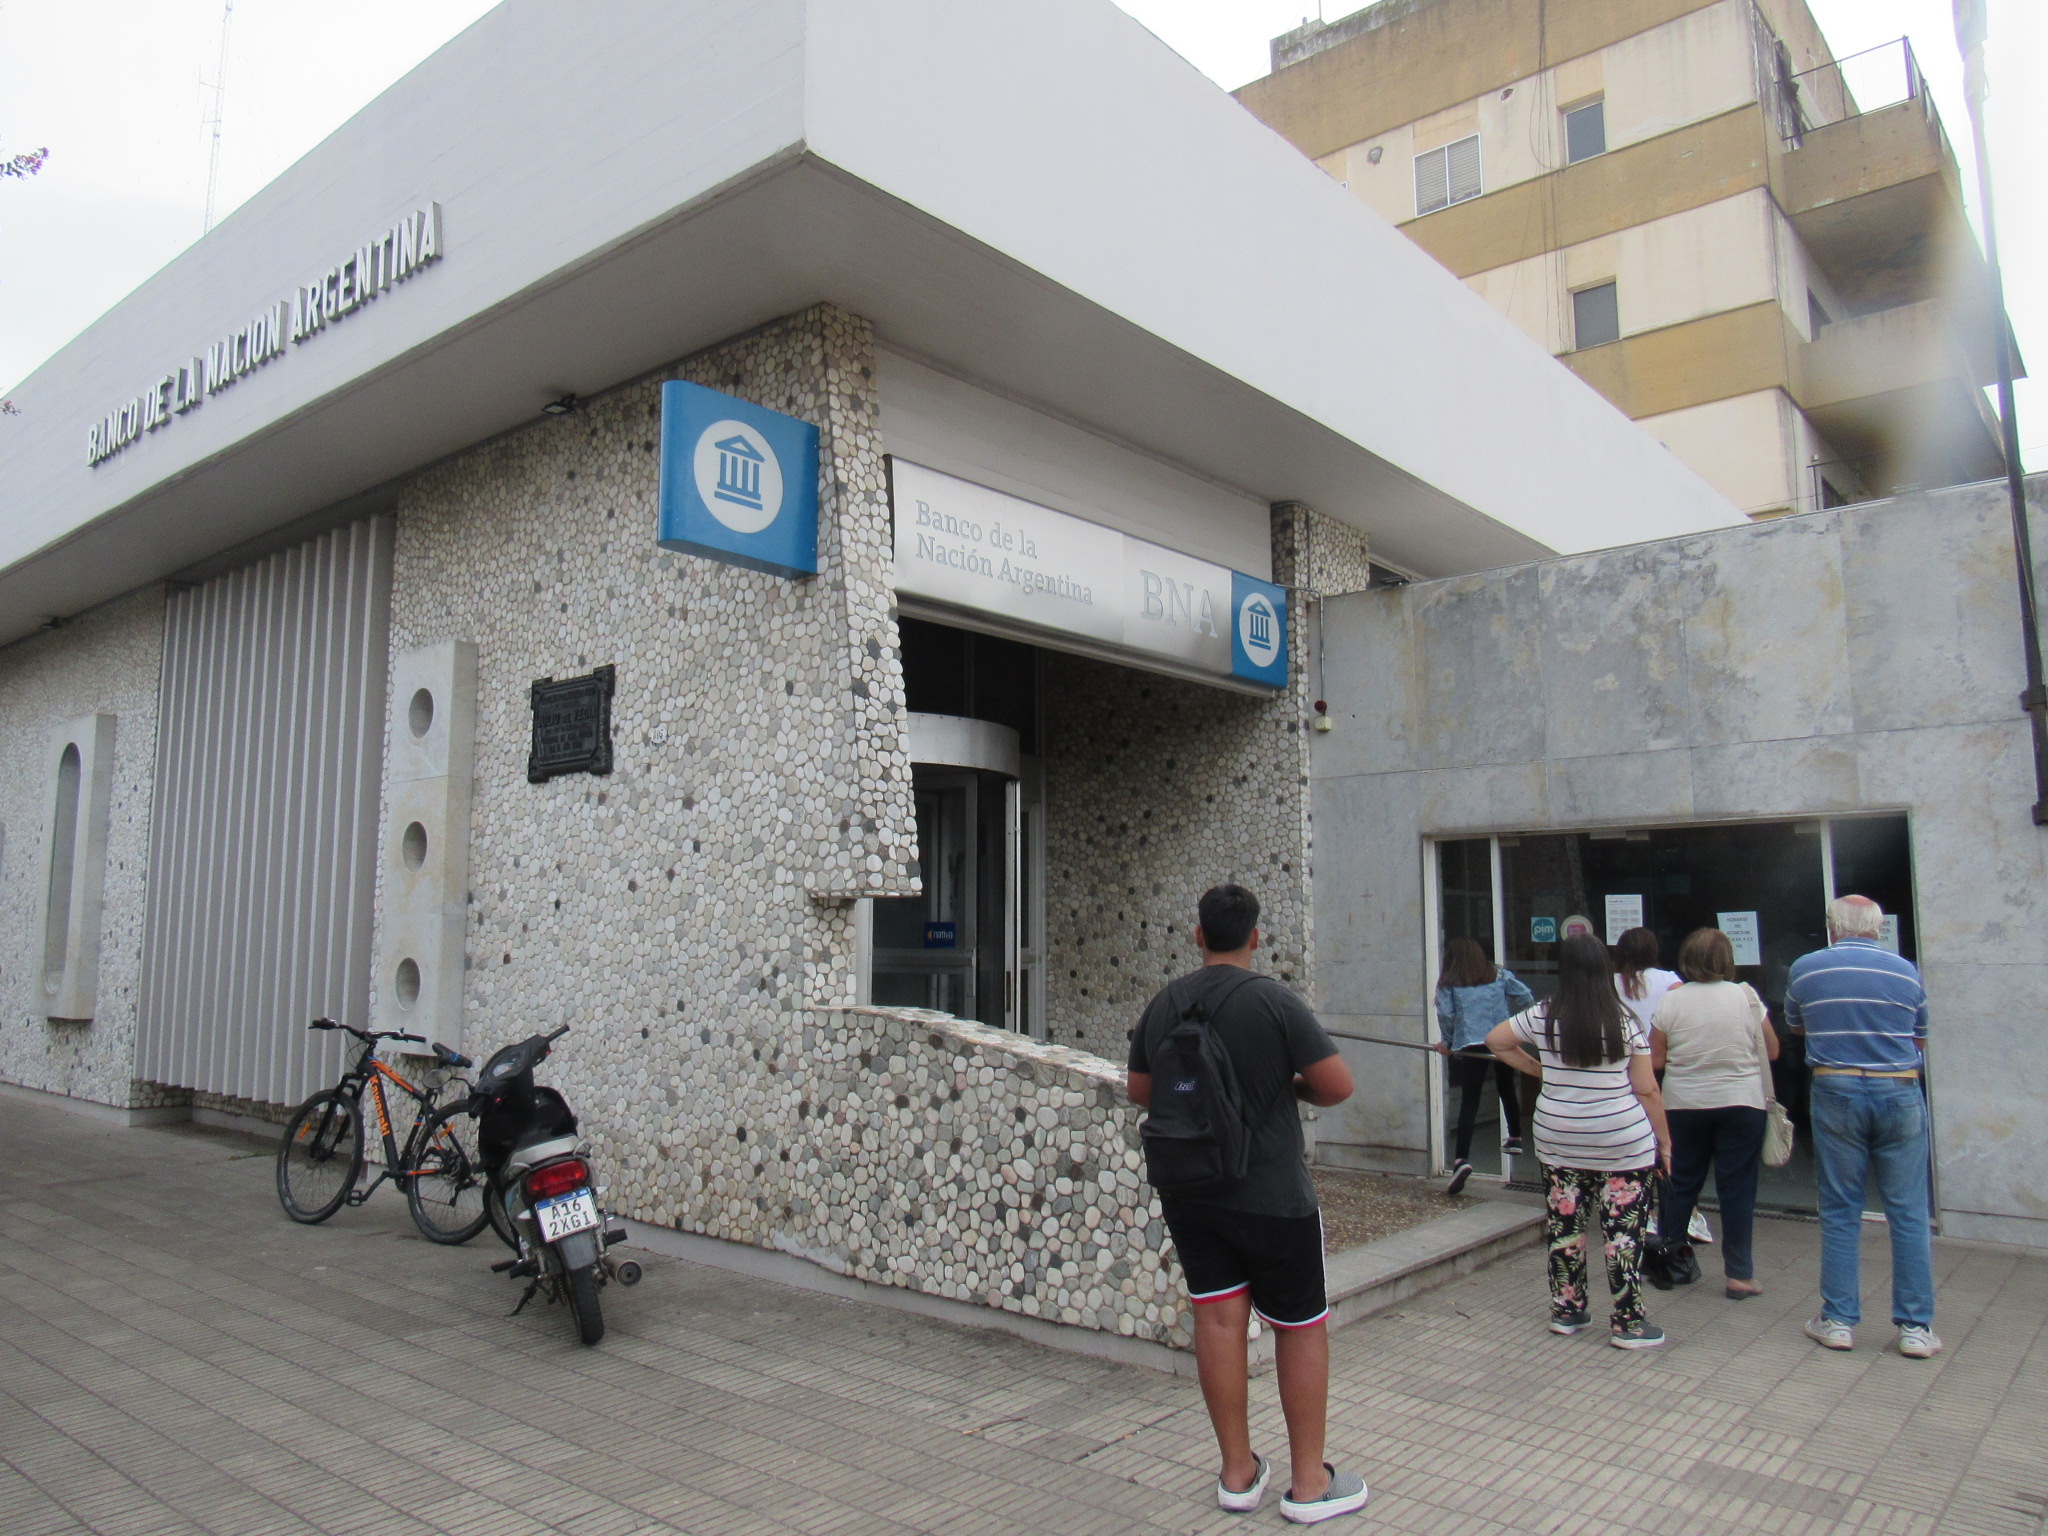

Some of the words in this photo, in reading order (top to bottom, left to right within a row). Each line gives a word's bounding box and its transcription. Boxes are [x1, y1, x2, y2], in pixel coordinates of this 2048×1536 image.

[87, 397, 144, 468] BANCO
[144, 375, 174, 433] DE
[173, 356, 202, 416] LA
[205, 300, 289, 396] NACION
[290, 200, 443, 345] ARGENTINA
[915, 499, 983, 542] Banco
[989, 522, 1013, 551] de
[1019, 529, 1038, 560] la
[915, 533, 994, 579] Nación
[997, 558, 1093, 606] Argentina
[1139, 569, 1219, 639] BNA
[933, 930, 954, 939] nativa
[1534, 922, 1554, 936] pim
[369, 1074, 390, 1137] Kawasaki
[549, 1211, 592, 1237] 2XGI
[551, 1198, 582, 1220] A16
